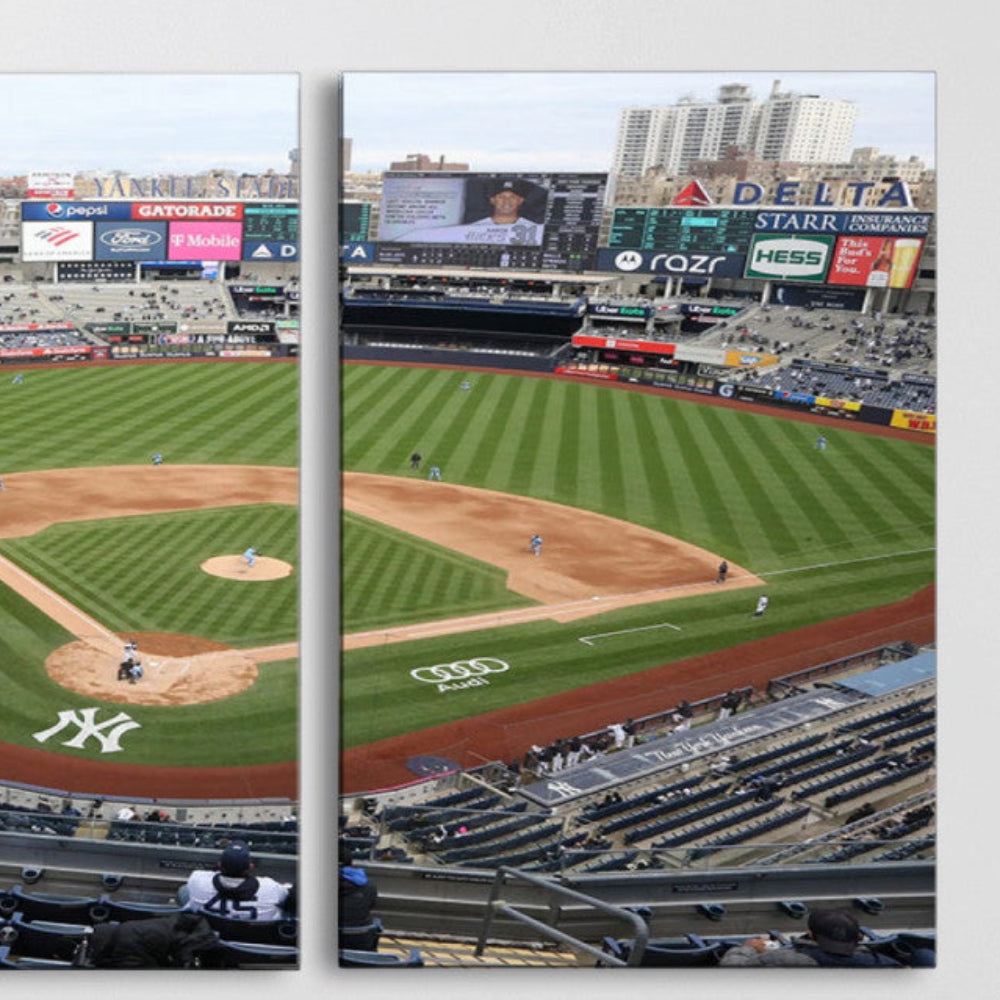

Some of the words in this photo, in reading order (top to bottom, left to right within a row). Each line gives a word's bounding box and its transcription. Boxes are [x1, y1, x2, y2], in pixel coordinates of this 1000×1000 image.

[734, 181, 914, 207] DELTA
[66, 205, 108, 218] pepsi
[138, 205, 237, 218] GATORADE
[755, 212, 839, 231] STARR
[850, 215, 930, 224] INSURANCE
[848, 223, 929, 233] COMPANIES
[187, 234, 240, 247] Mobile
[841, 239, 869, 248] This
[755, 250, 823, 265] HESS
[838, 247, 873, 257] Bud's
[650, 254, 727, 274] razr
[837, 256, 858, 265] For
[595, 306, 619, 314] Uber
[688, 305, 712, 313] Uber
[32, 707, 142, 754] NY
